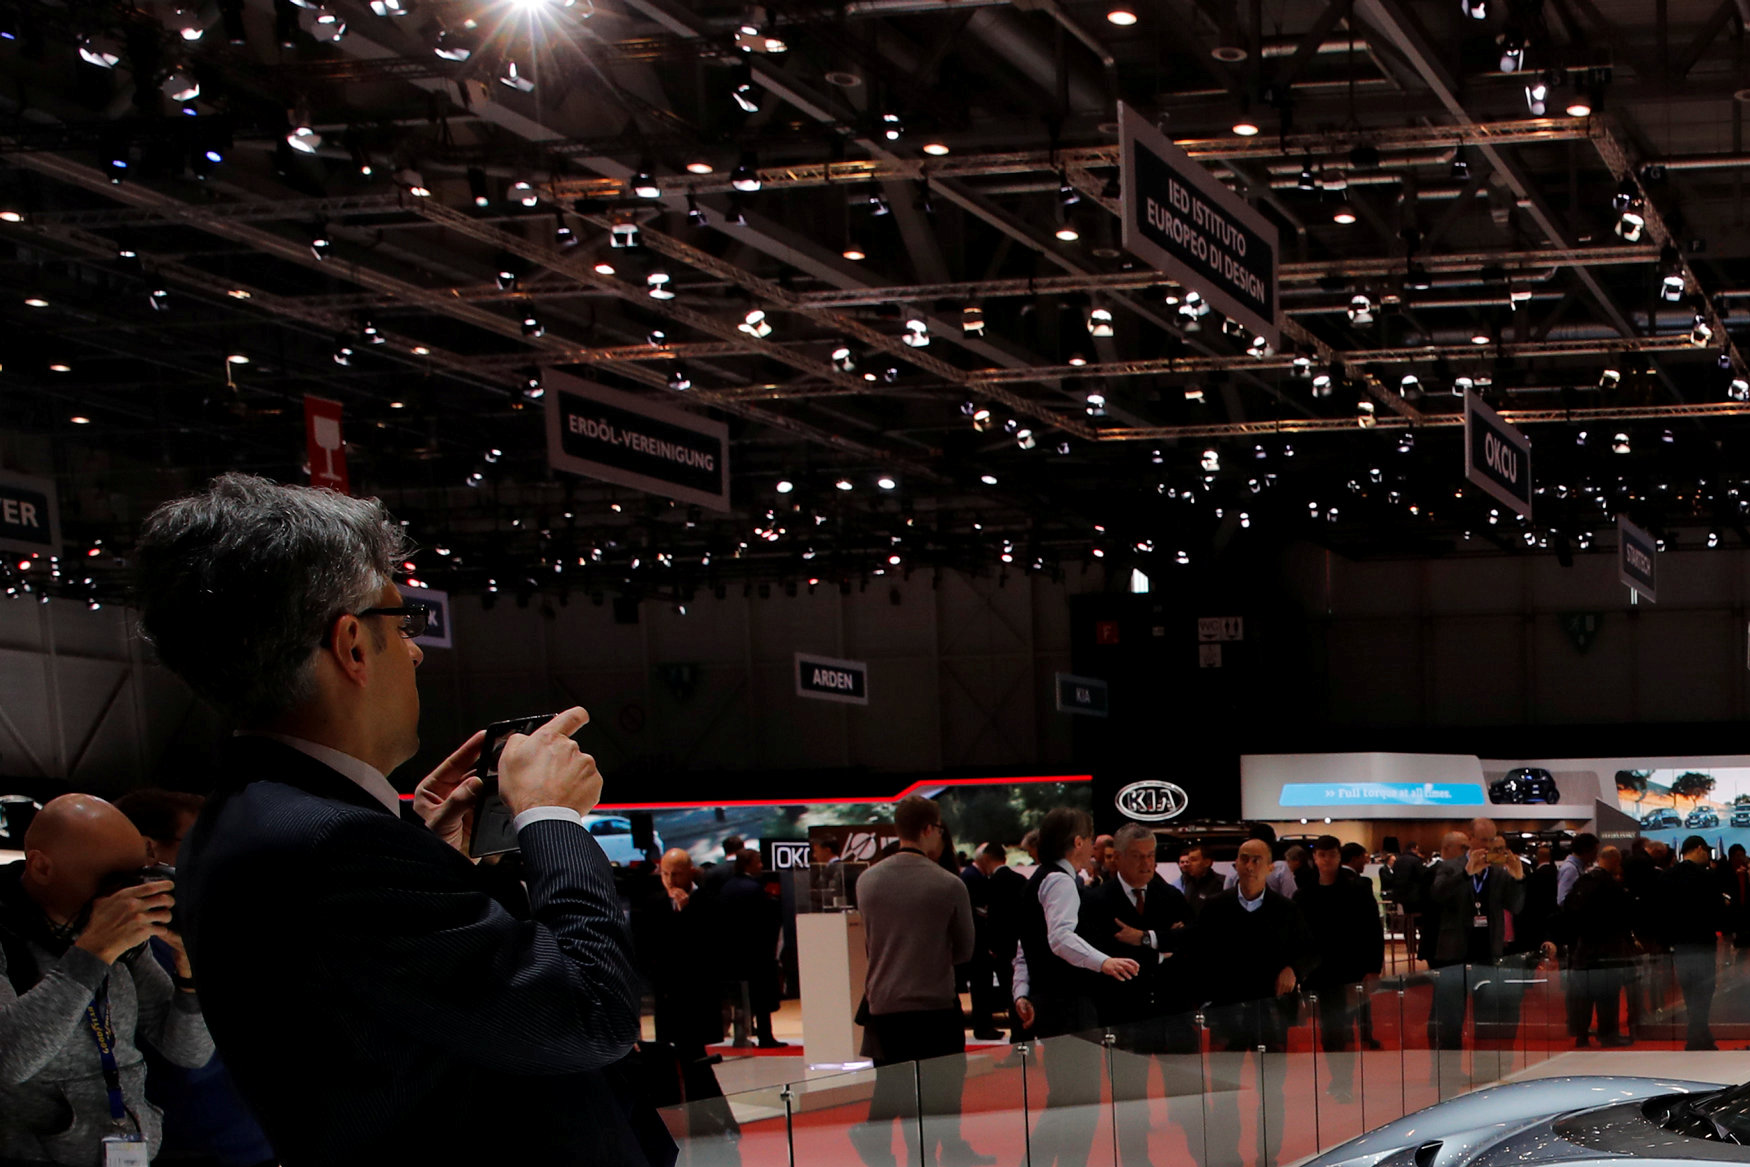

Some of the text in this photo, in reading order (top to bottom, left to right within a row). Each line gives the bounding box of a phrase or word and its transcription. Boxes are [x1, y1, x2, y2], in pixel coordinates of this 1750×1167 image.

[1168, 178, 1246, 257] IED ISTITUTO
[1146, 196, 1265, 304] EUROPEO DI DESIGN
[568, 413, 714, 471] ERDÖL-VEREINIGUNG
[1485, 431, 1517, 484] OKCU
[0, 497, 40, 528] ER
[812, 669, 854, 691] ARDEN
[1075, 687, 1092, 704] KIA
[1126, 788, 1177, 812] KIA
[1338, 788, 1361, 798] Full
[1363, 787, 1397, 800] torque
